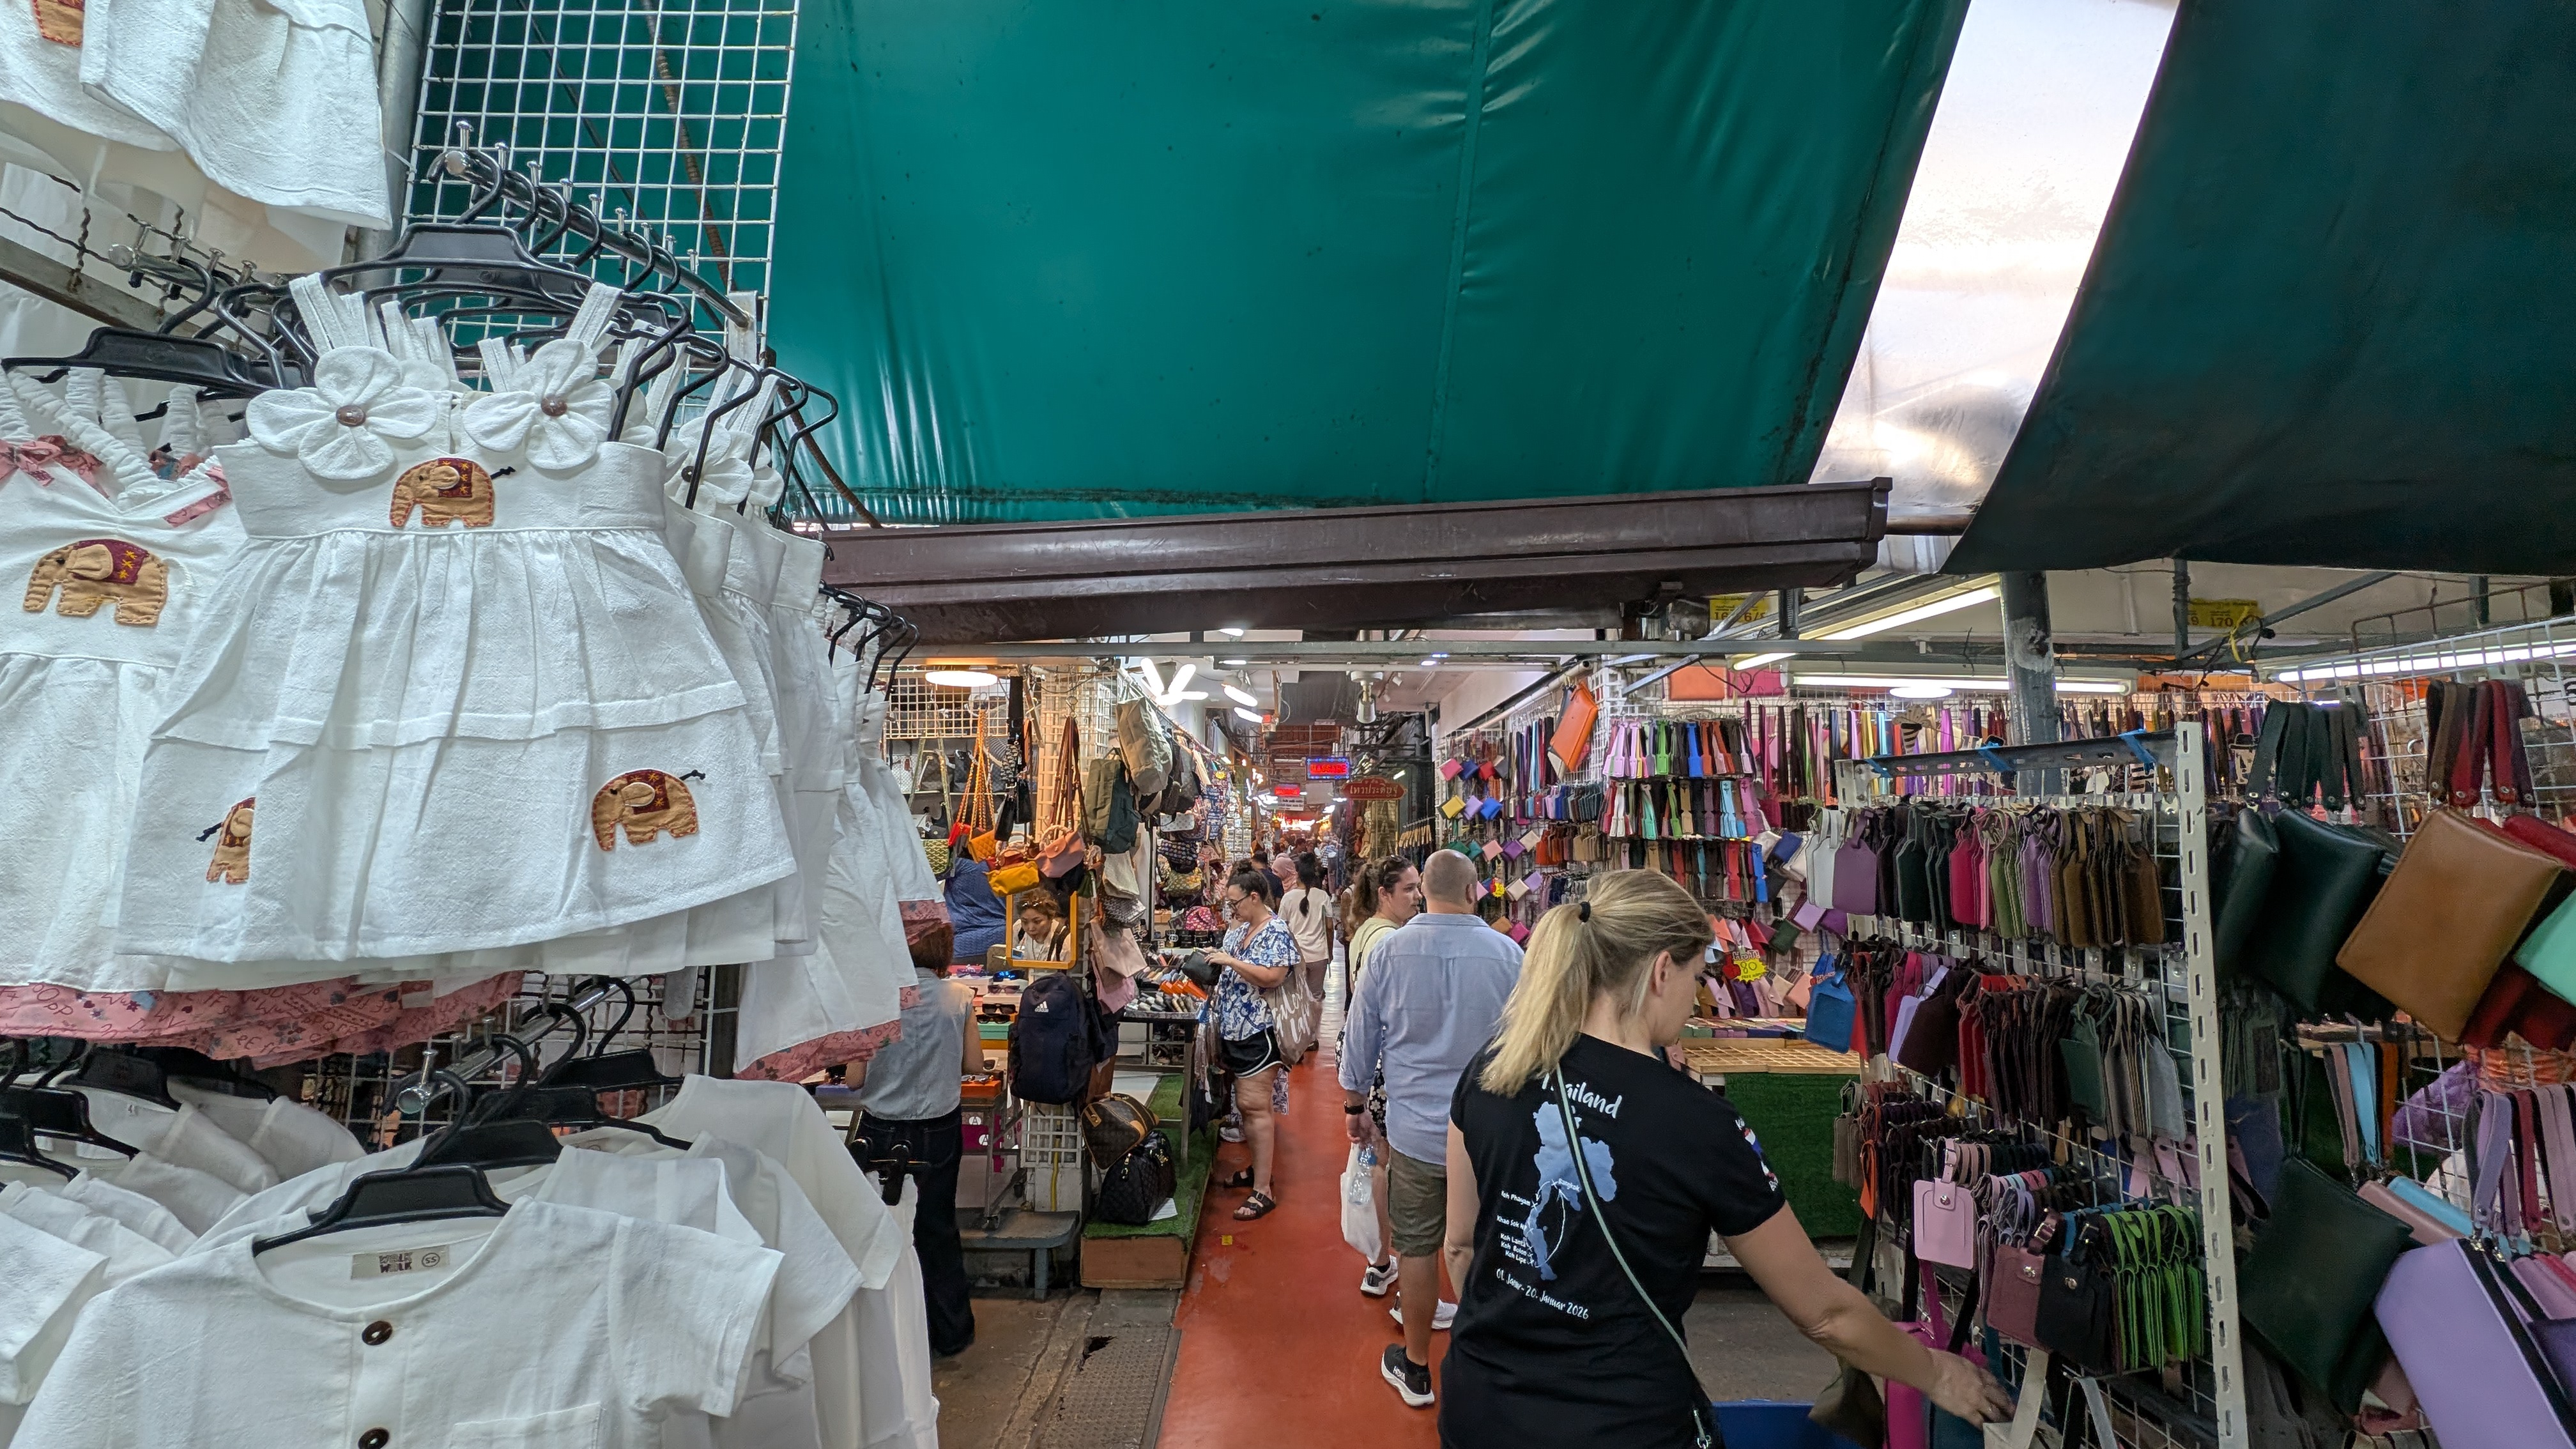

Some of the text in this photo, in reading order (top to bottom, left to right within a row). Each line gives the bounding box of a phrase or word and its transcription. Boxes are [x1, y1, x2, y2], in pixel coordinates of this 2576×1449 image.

[2211, 617, 2234, 627] 170
[1310, 764, 1347, 773] MASSAGE
[1740, 961, 1758, 974] 80
[1542, 1073, 1623, 1119] ailand
[1558, 1178, 1580, 1192] Bangkok
[1501, 1241, 1511, 1250] Koh
[1505, 1250, 1515, 1259] Koh
[1525, 1285, 1538, 1299] 20.
[1539, 1290, 1566, 1311] Januar
[1567, 1302, 1590, 1320] 2026
